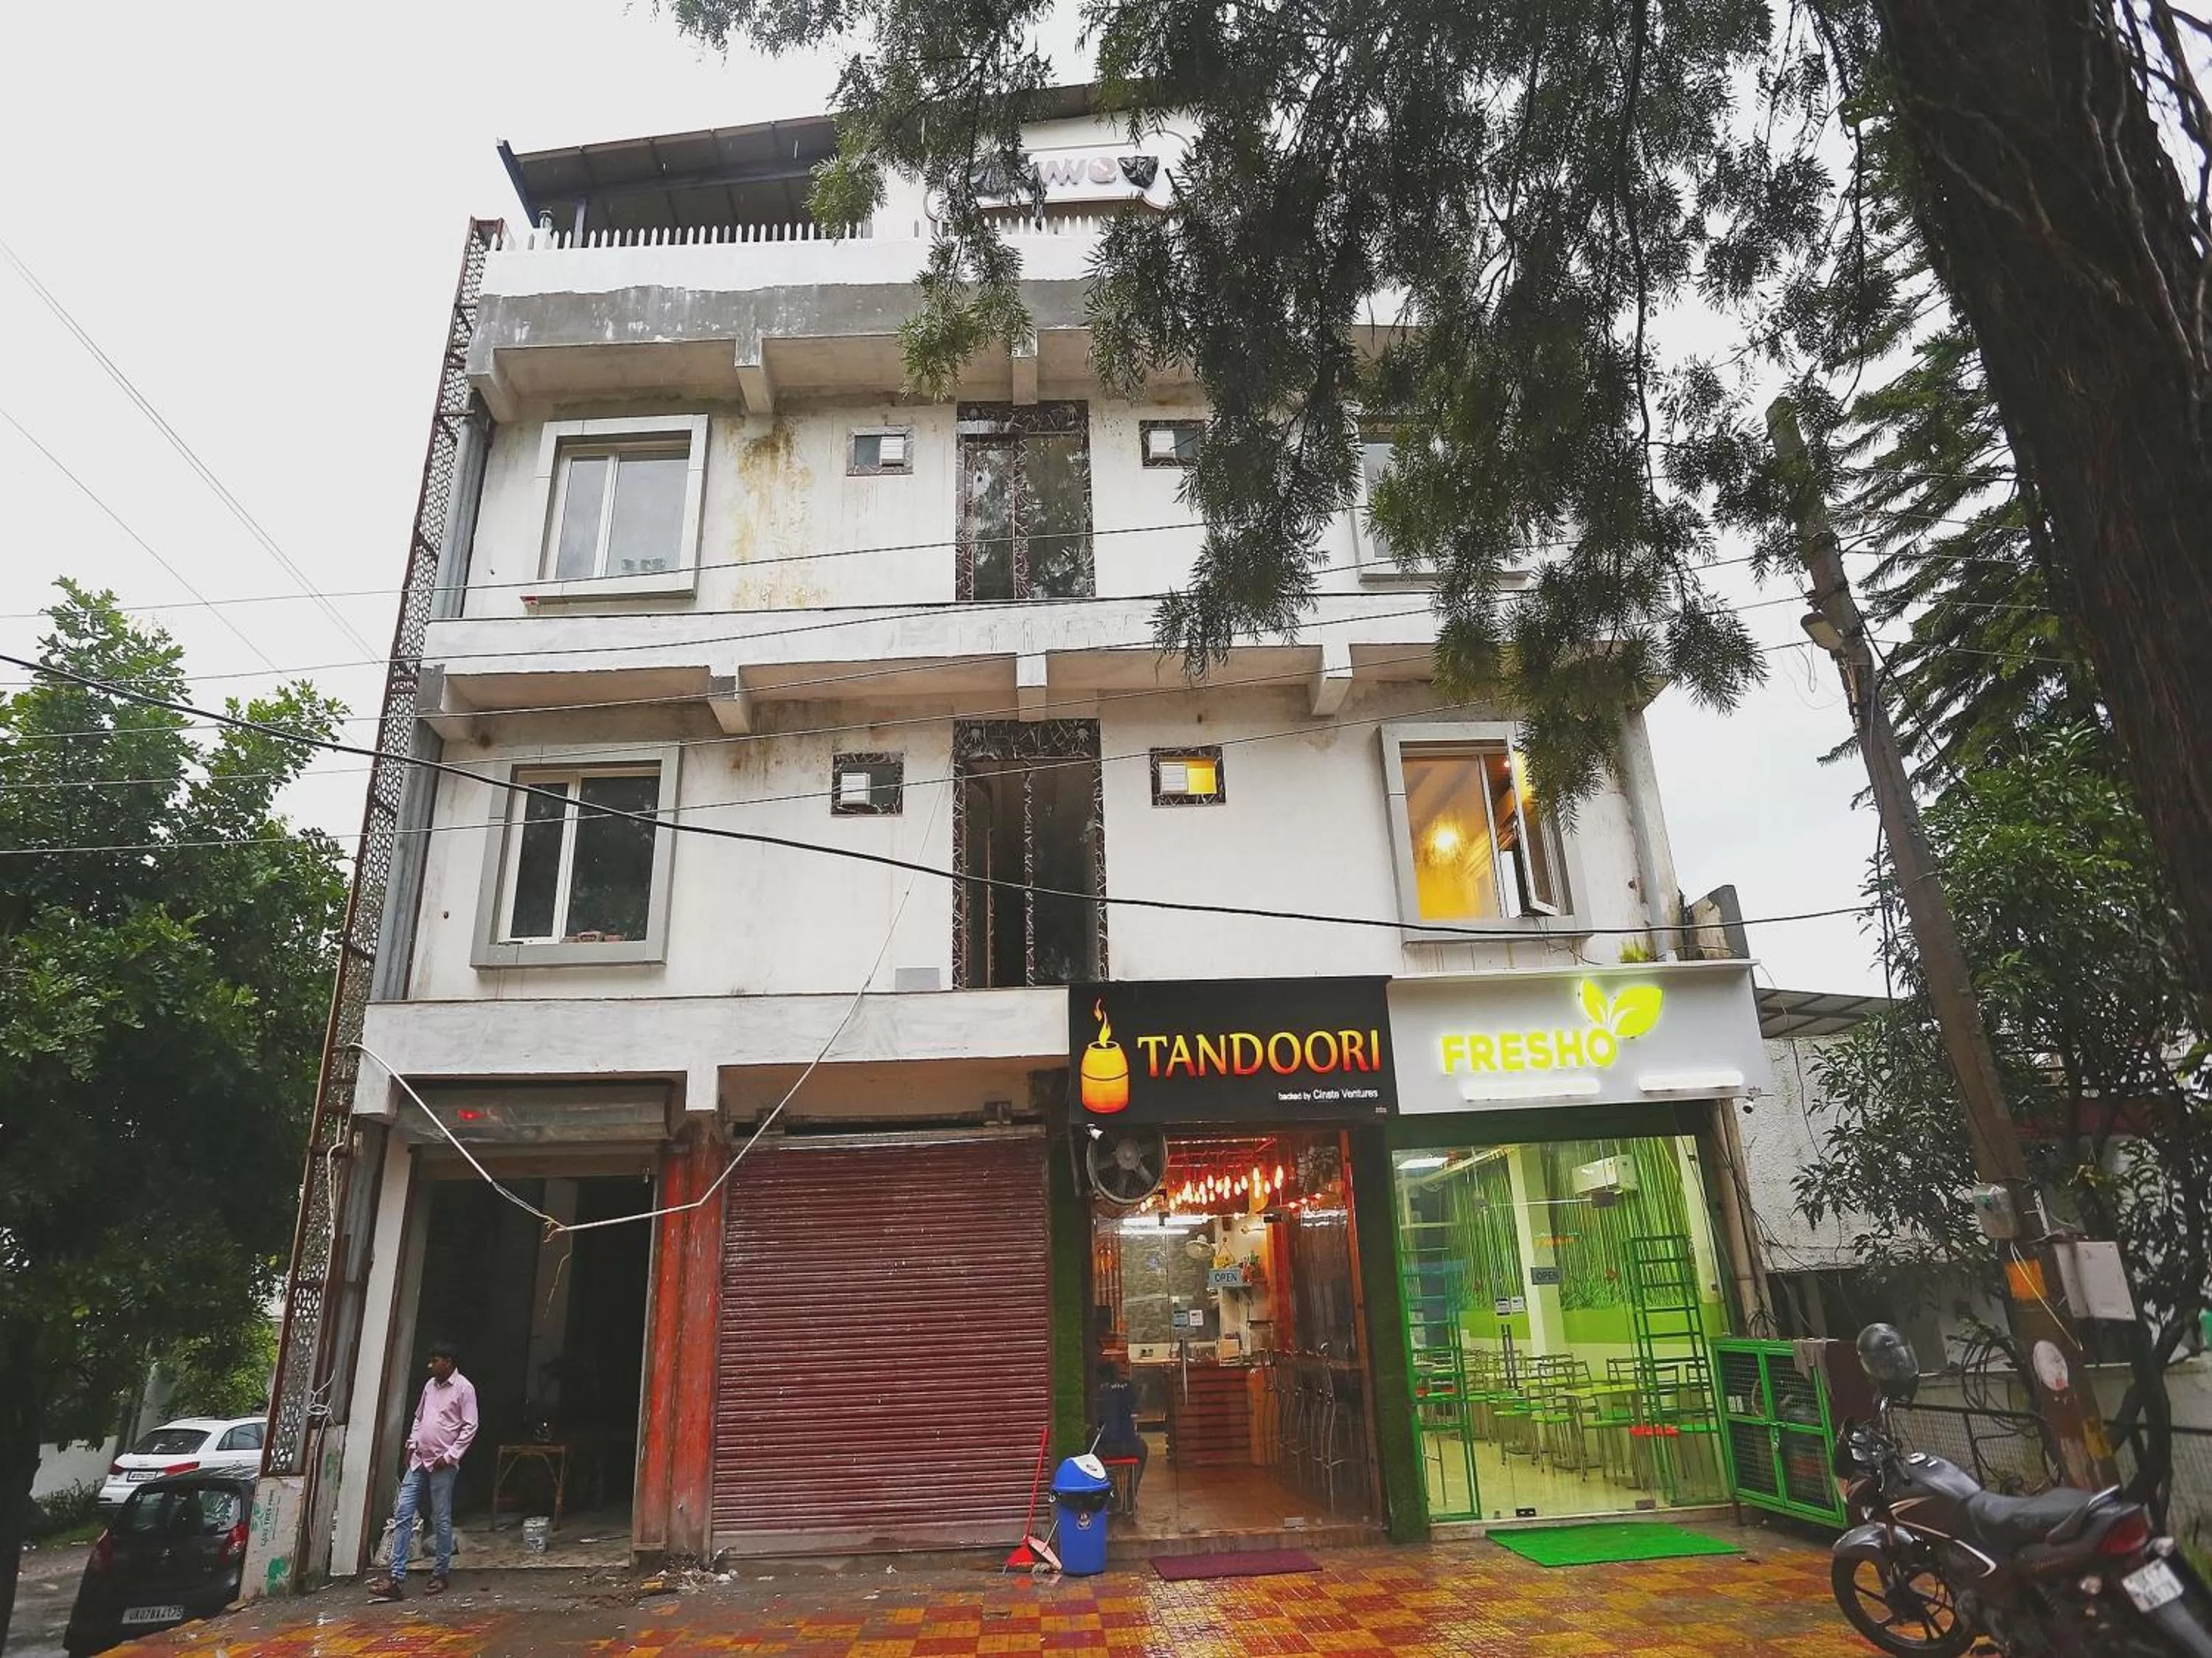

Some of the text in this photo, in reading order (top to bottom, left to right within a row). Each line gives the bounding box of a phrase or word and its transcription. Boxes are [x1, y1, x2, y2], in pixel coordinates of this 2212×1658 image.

[1137, 1029, 1380, 1078] TANDOORI
[1441, 1027, 1617, 1075] FRESHO
[1303, 1091, 1311, 1101] by
[1341, 1088, 1378, 1098] Ventures
[1214, 1272, 1237, 1283] OPEN
[1536, 1270, 1559, 1281] OPEN
